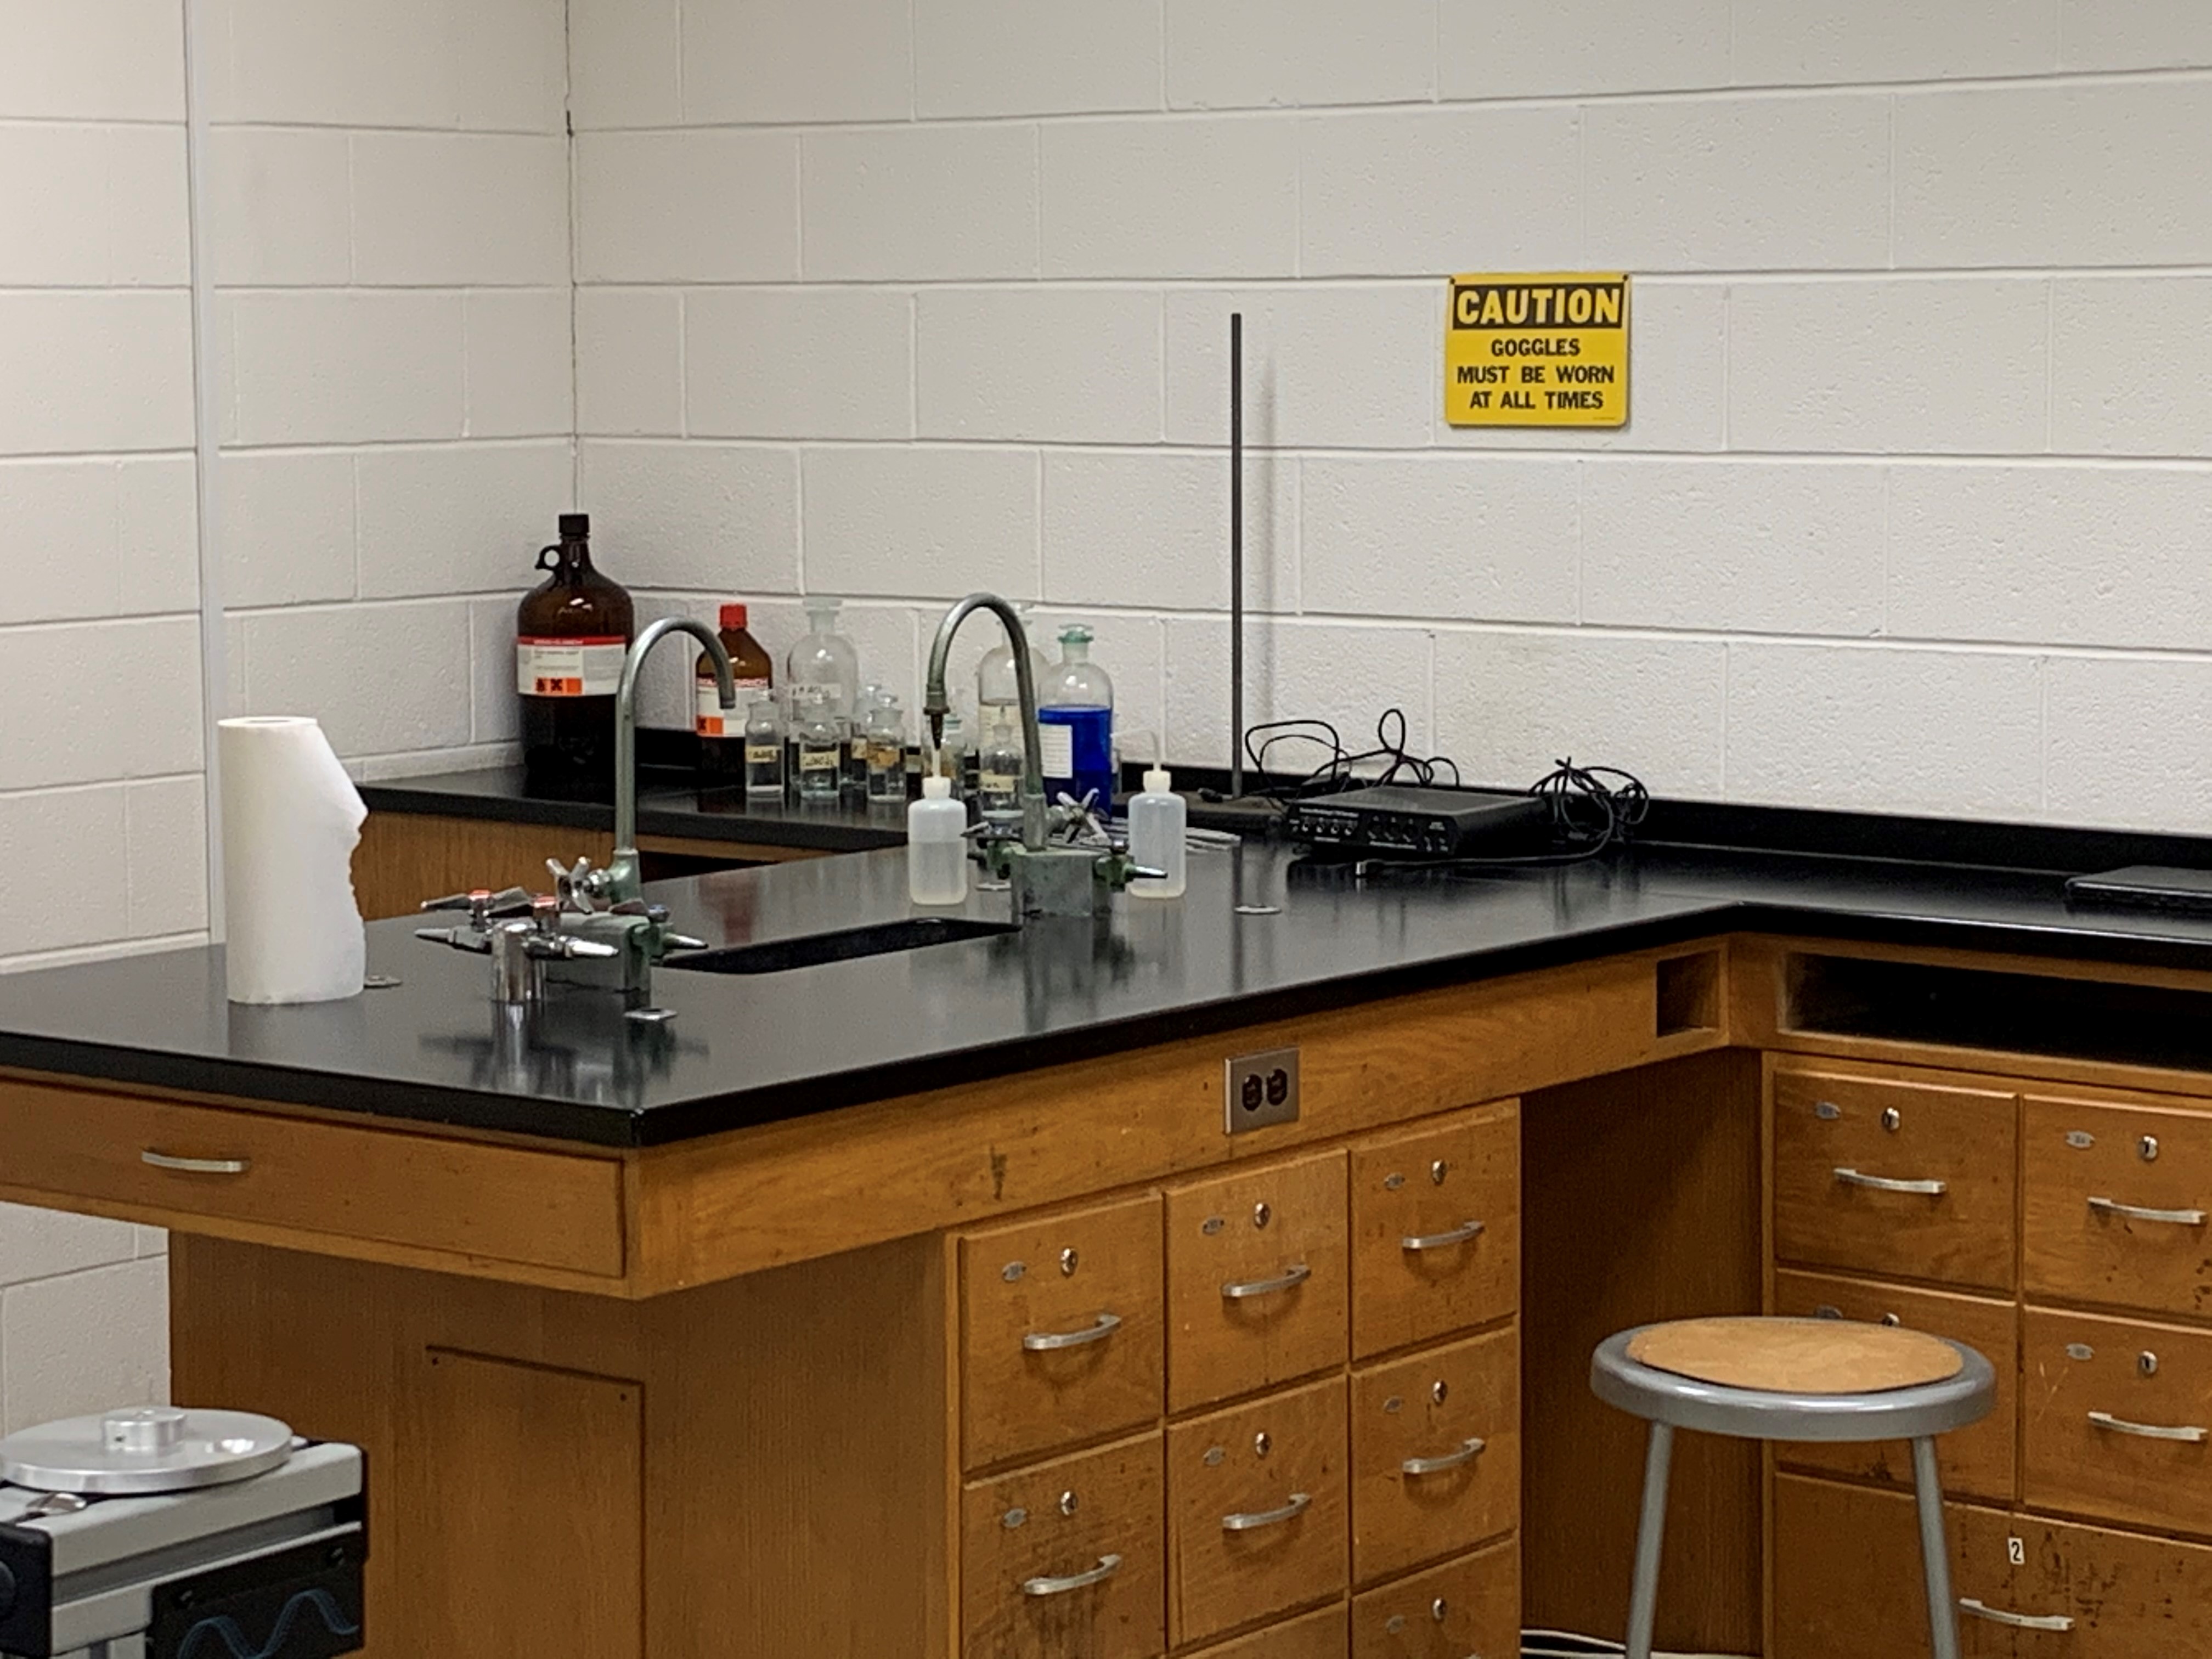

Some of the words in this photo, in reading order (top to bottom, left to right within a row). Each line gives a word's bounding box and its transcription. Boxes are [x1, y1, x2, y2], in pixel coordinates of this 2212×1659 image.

[1457, 289, 1620, 324] CAUTION
[1491, 338, 1581, 357] GOGGLES
[1457, 366, 1510, 383] MUST
[1521, 366, 1545, 383] BE
[1556, 365, 1615, 383] WORN
[1469, 391, 1492, 409] AT
[1500, 391, 1536, 409] ALL
[1544, 391, 1604, 410] TIMES
[2012, 1541, 2021, 1562] 2
